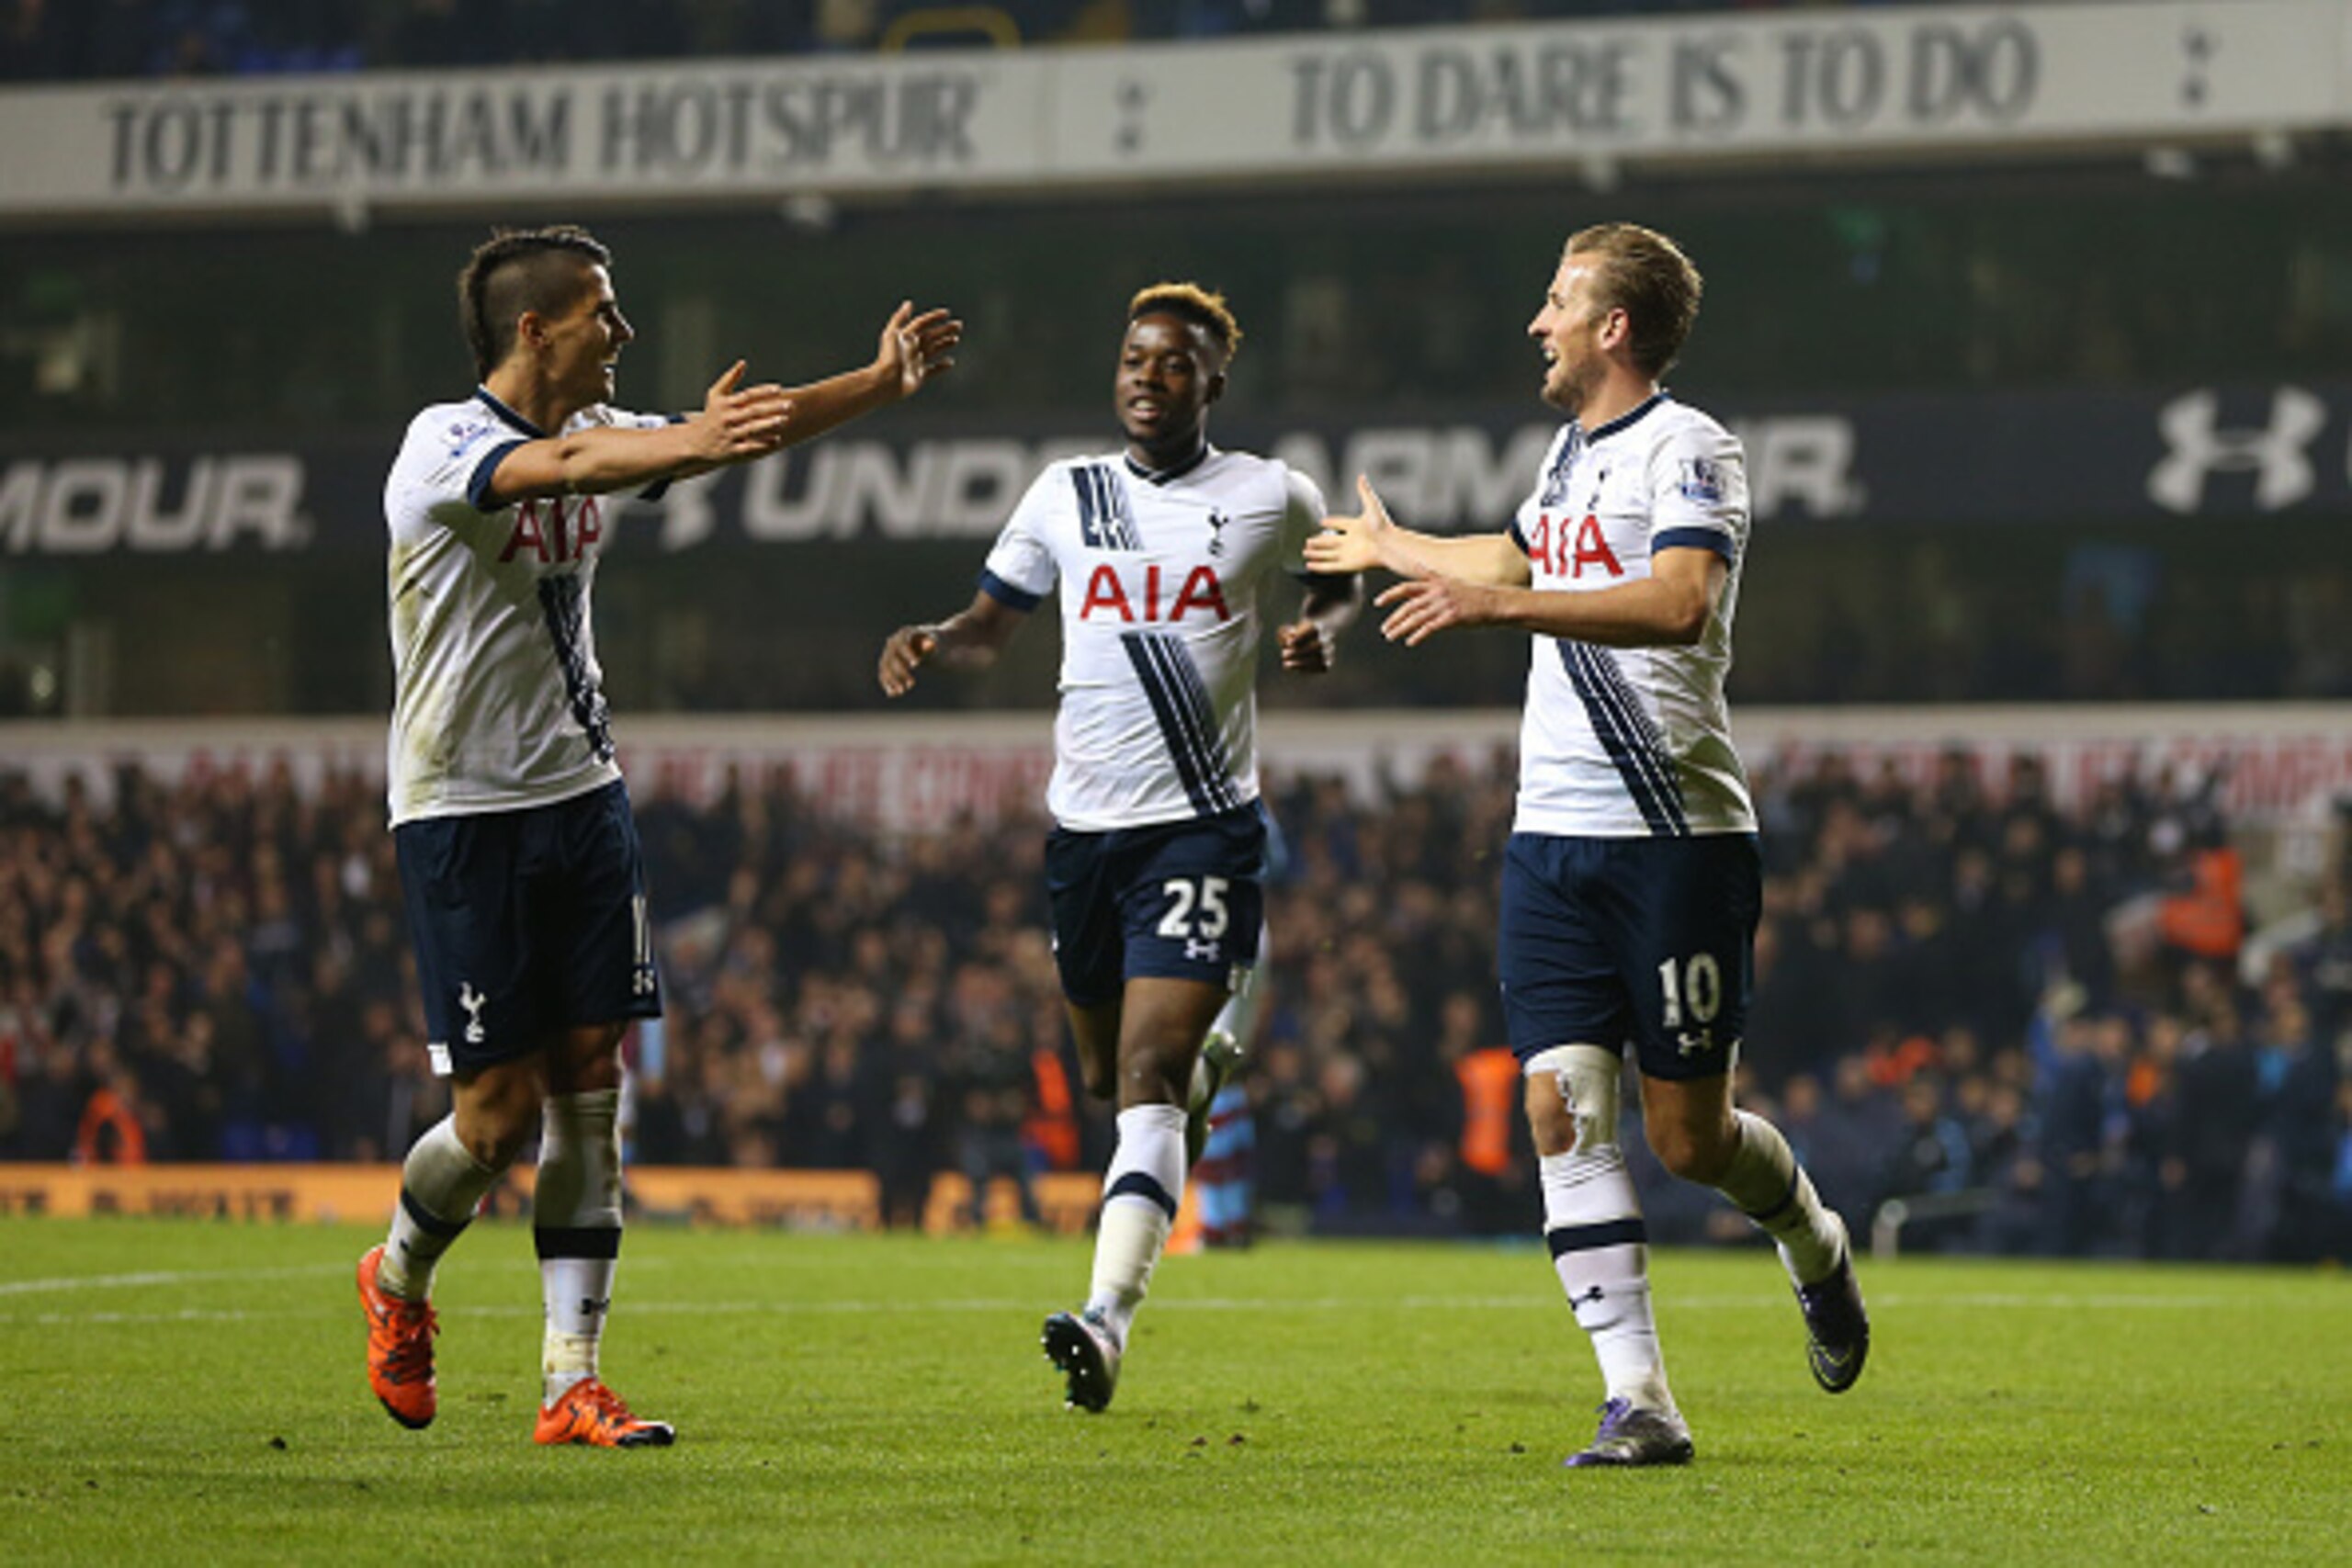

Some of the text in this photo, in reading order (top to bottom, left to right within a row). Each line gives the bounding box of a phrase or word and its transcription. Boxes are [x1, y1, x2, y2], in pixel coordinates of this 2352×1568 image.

[1288, 16, 2041, 149] TO DARE IS TO DO
[105, 70, 981, 187] TOTTENHAM HOTSPUR
[499, 496, 604, 564] AIA
[1528, 513, 1624, 579] AIA
[1080, 563, 1231, 623] AIA
[1157, 875, 1228, 939] 25
[1658, 953, 1721, 1028] 10
